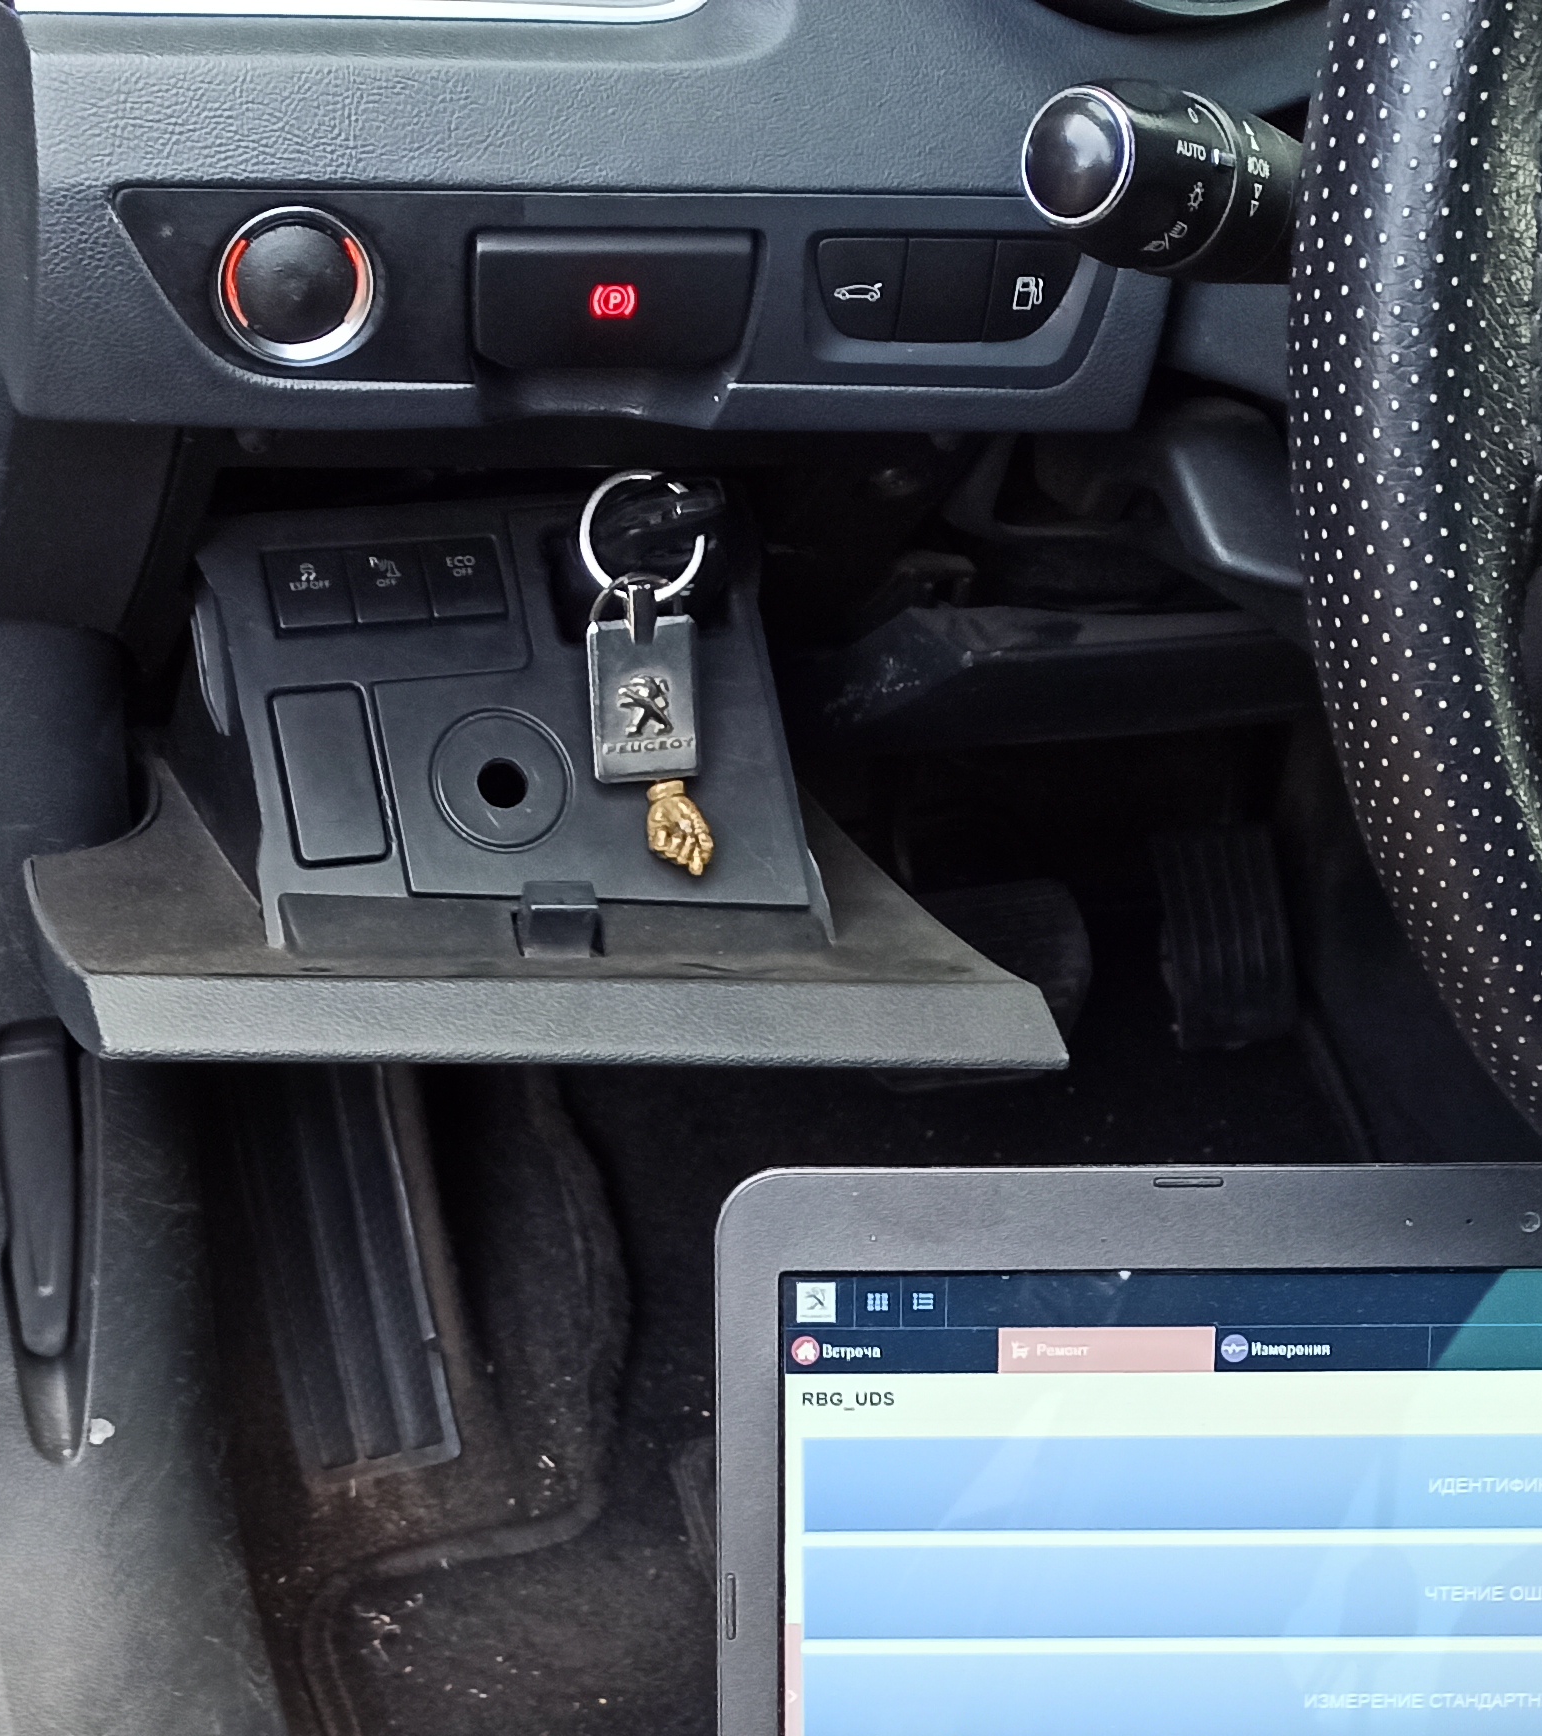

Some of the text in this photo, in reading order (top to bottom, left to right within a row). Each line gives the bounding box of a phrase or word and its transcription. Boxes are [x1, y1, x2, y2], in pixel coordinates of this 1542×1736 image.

[1176, 139, 1207, 162] AUTO
[445, 555, 476, 567] ECO
[1036, 1343, 1090, 1357] Ремонт
[801, 1391, 895, 1410] RBG_UDS
[1425, 1585, 1505, 1603] ЧТЕНИЕ
[1304, 1692, 1425, 1710] ИЗМЕРЕНИЕ
